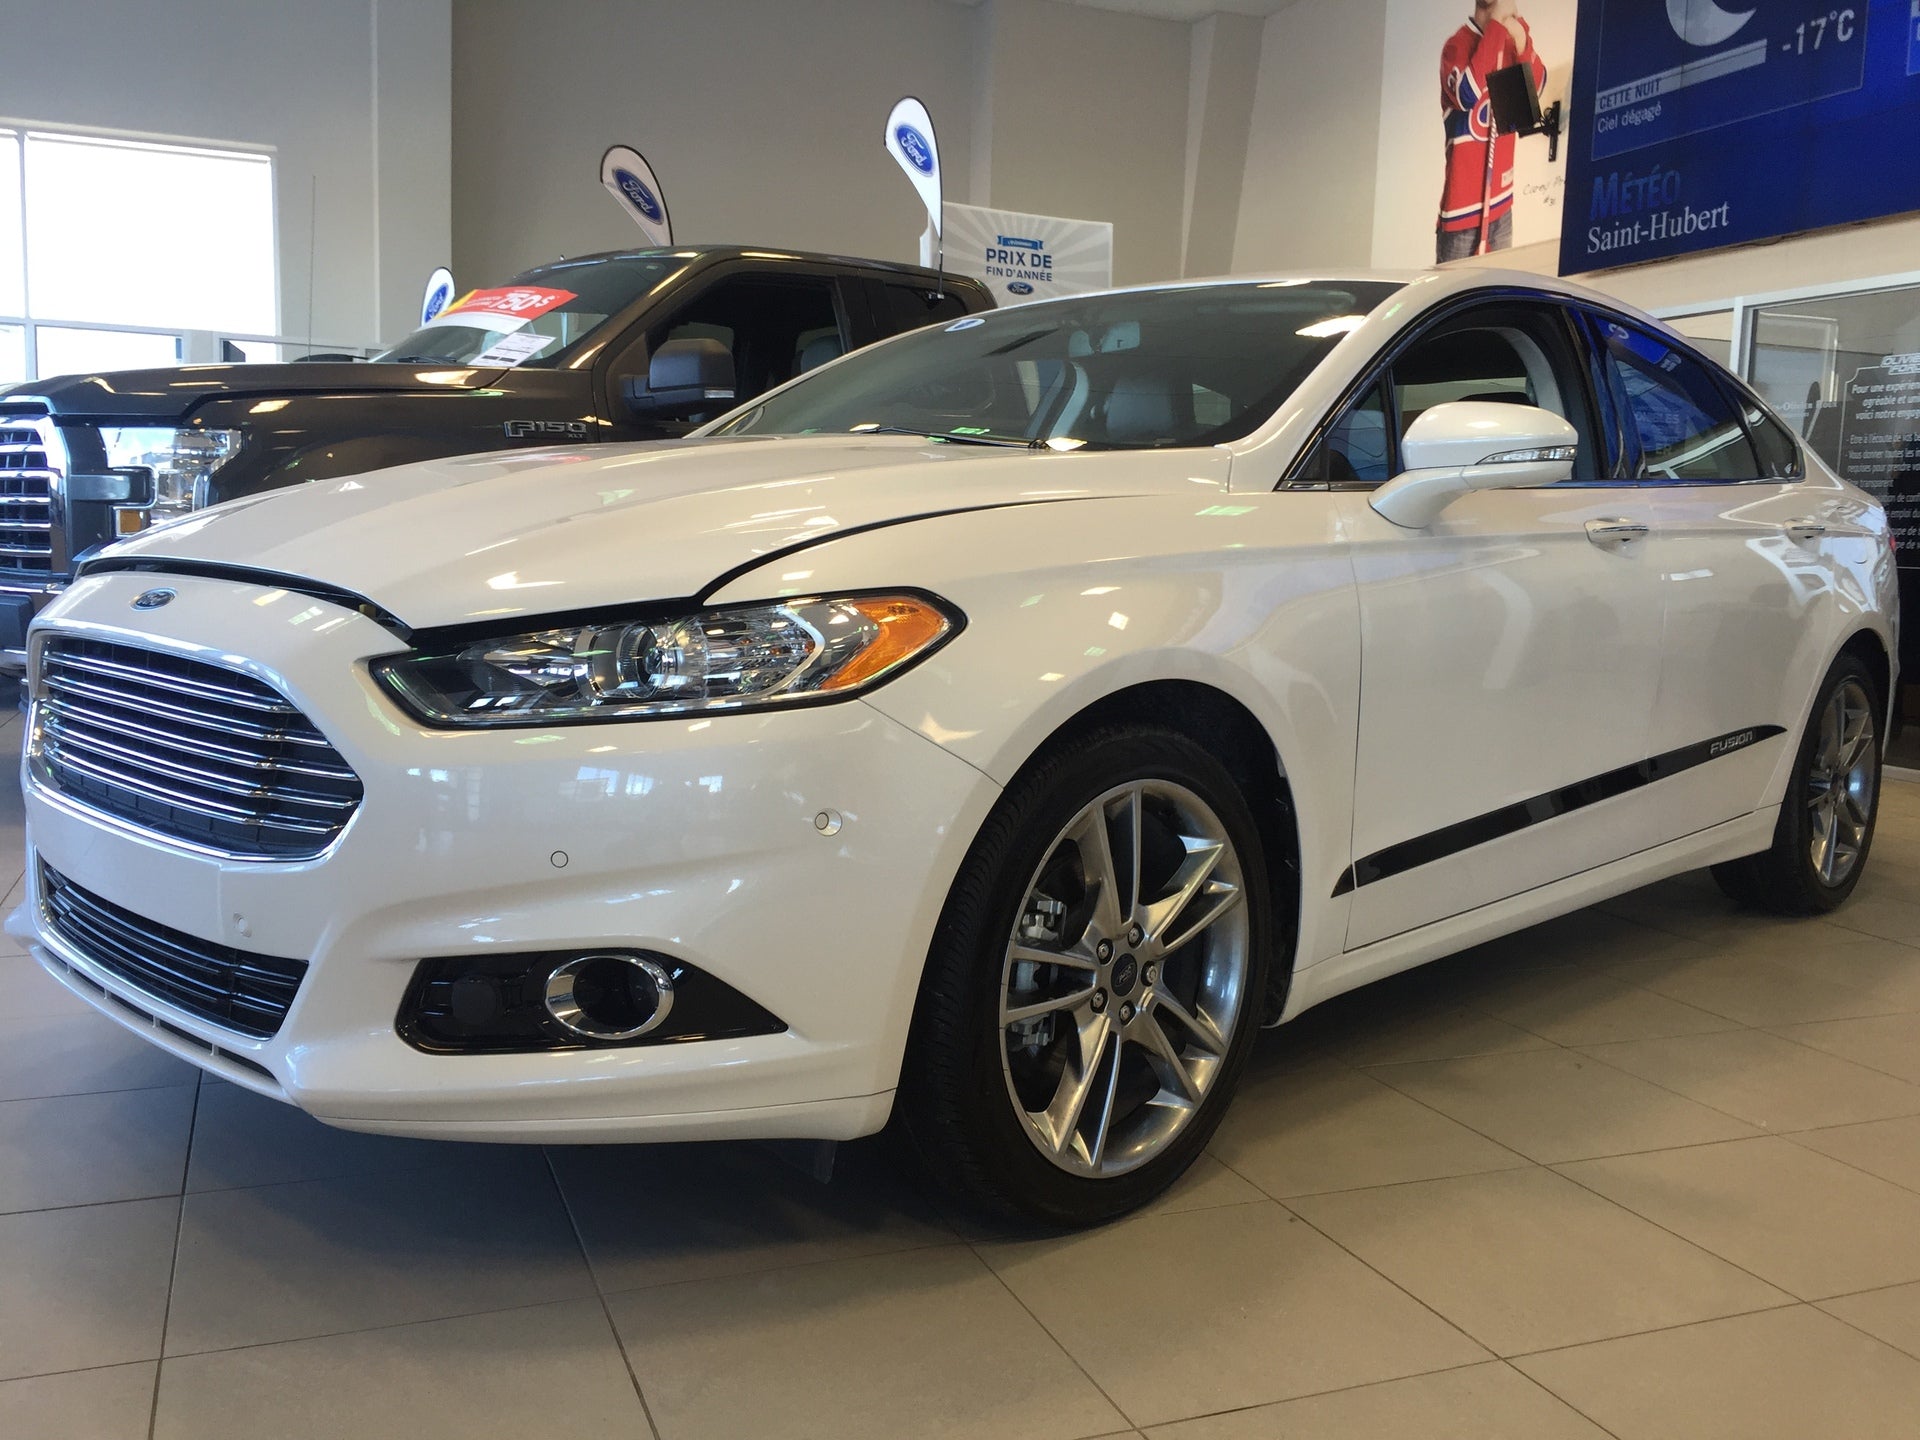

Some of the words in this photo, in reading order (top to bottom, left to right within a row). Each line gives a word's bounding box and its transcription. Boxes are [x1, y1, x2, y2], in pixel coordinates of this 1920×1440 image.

[1600, 86, 1631, 110] CETTE
[1635, 78, 1663, 99] NUIT
[1597, 113, 1618, 133] Ciel
[1621, 101, 1662, 126] dégagé
[1589, 164, 1681, 221] MÉTÉO
[1587, 201, 1730, 254] Saint-Hubert
[986, 248, 1026, 267] PRIX
[1031, 253, 1052, 269] DE
[986, 266, 1004, 277] FIN
[1006, 267, 1053, 282] D'ANNÉE
[1709, 730, 1753, 755] FUSION
